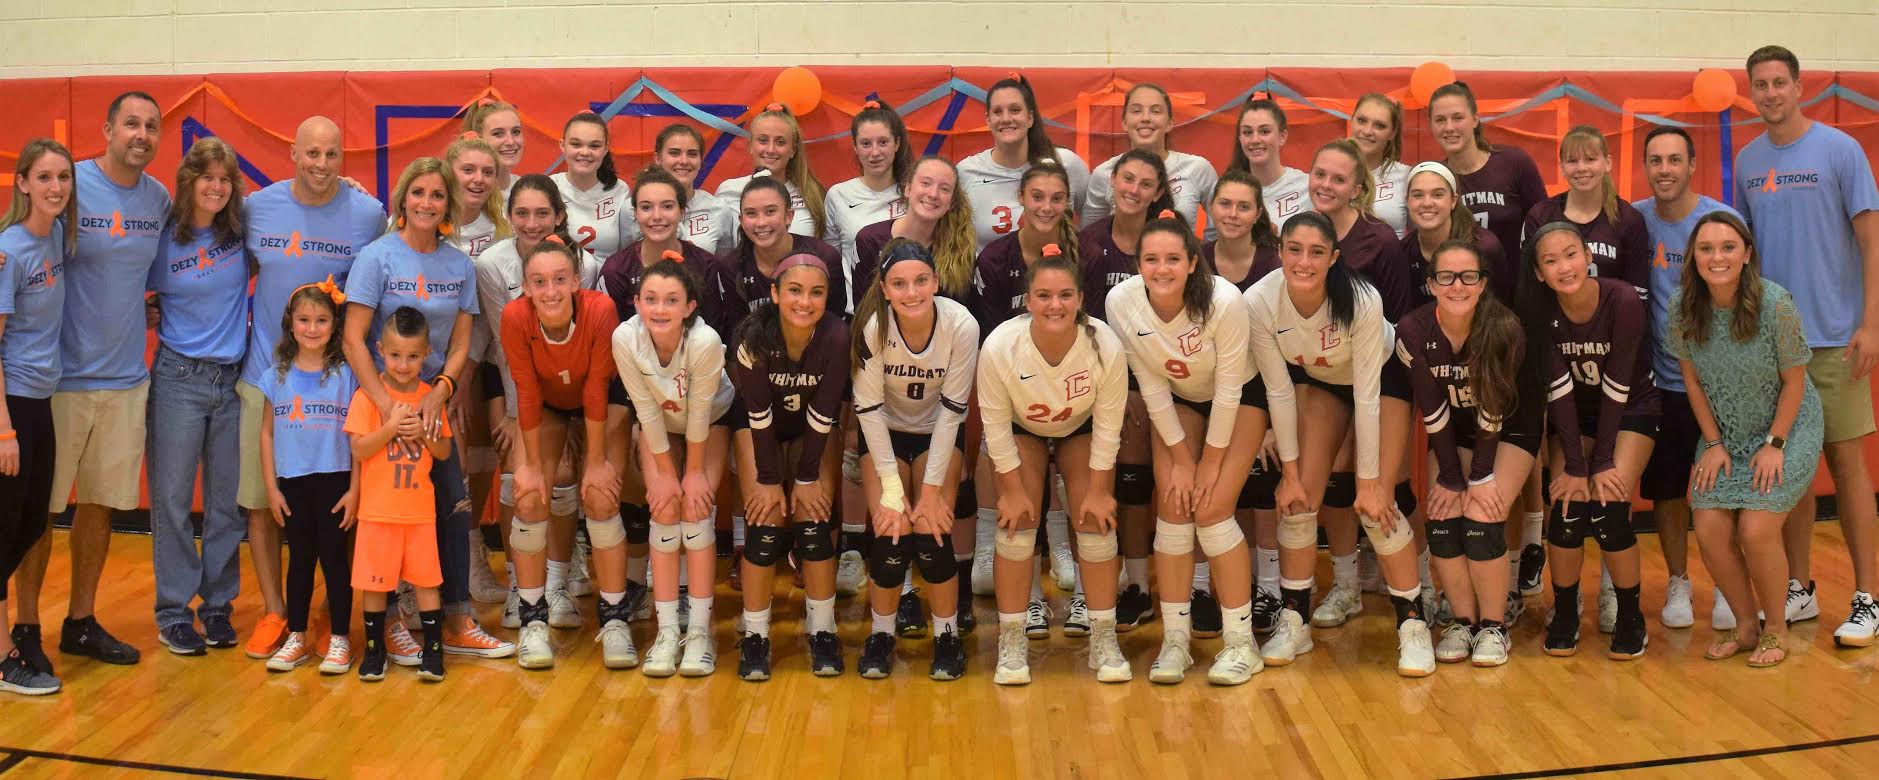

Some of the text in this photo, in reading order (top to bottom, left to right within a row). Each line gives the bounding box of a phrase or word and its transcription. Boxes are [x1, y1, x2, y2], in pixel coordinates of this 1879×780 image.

[1747, 174, 1819, 189] DEZY STRONG
[1373, 182, 1393, 202] C
[596, 197, 615, 220] C
[1275, 192, 1299, 218] C
[82, 217, 159, 231] DEZY STRONG
[689, 213, 710, 236] C
[991, 206, 1025, 234] 3
[260, 237, 352, 256] DEZY STRONG
[578, 226, 597, 254] 2
[172, 256, 198, 273] DEZY
[389, 281, 416, 291] DEZY
[1177, 326, 1202, 357] C
[558, 369, 571, 385] 1
[1165, 358, 1191, 379] 9
[1570, 360, 1601, 386] 19
[906, 382, 926, 400] 8
[1063, 369, 1091, 401] C
[661, 399, 687, 412] 4
[783, 393, 801, 411] 3
[1447, 384, 1475, 408] 15
[304, 404, 348, 417] STRONG
[1026, 403, 1073, 423] 24
[393, 463, 420, 489] IT.
